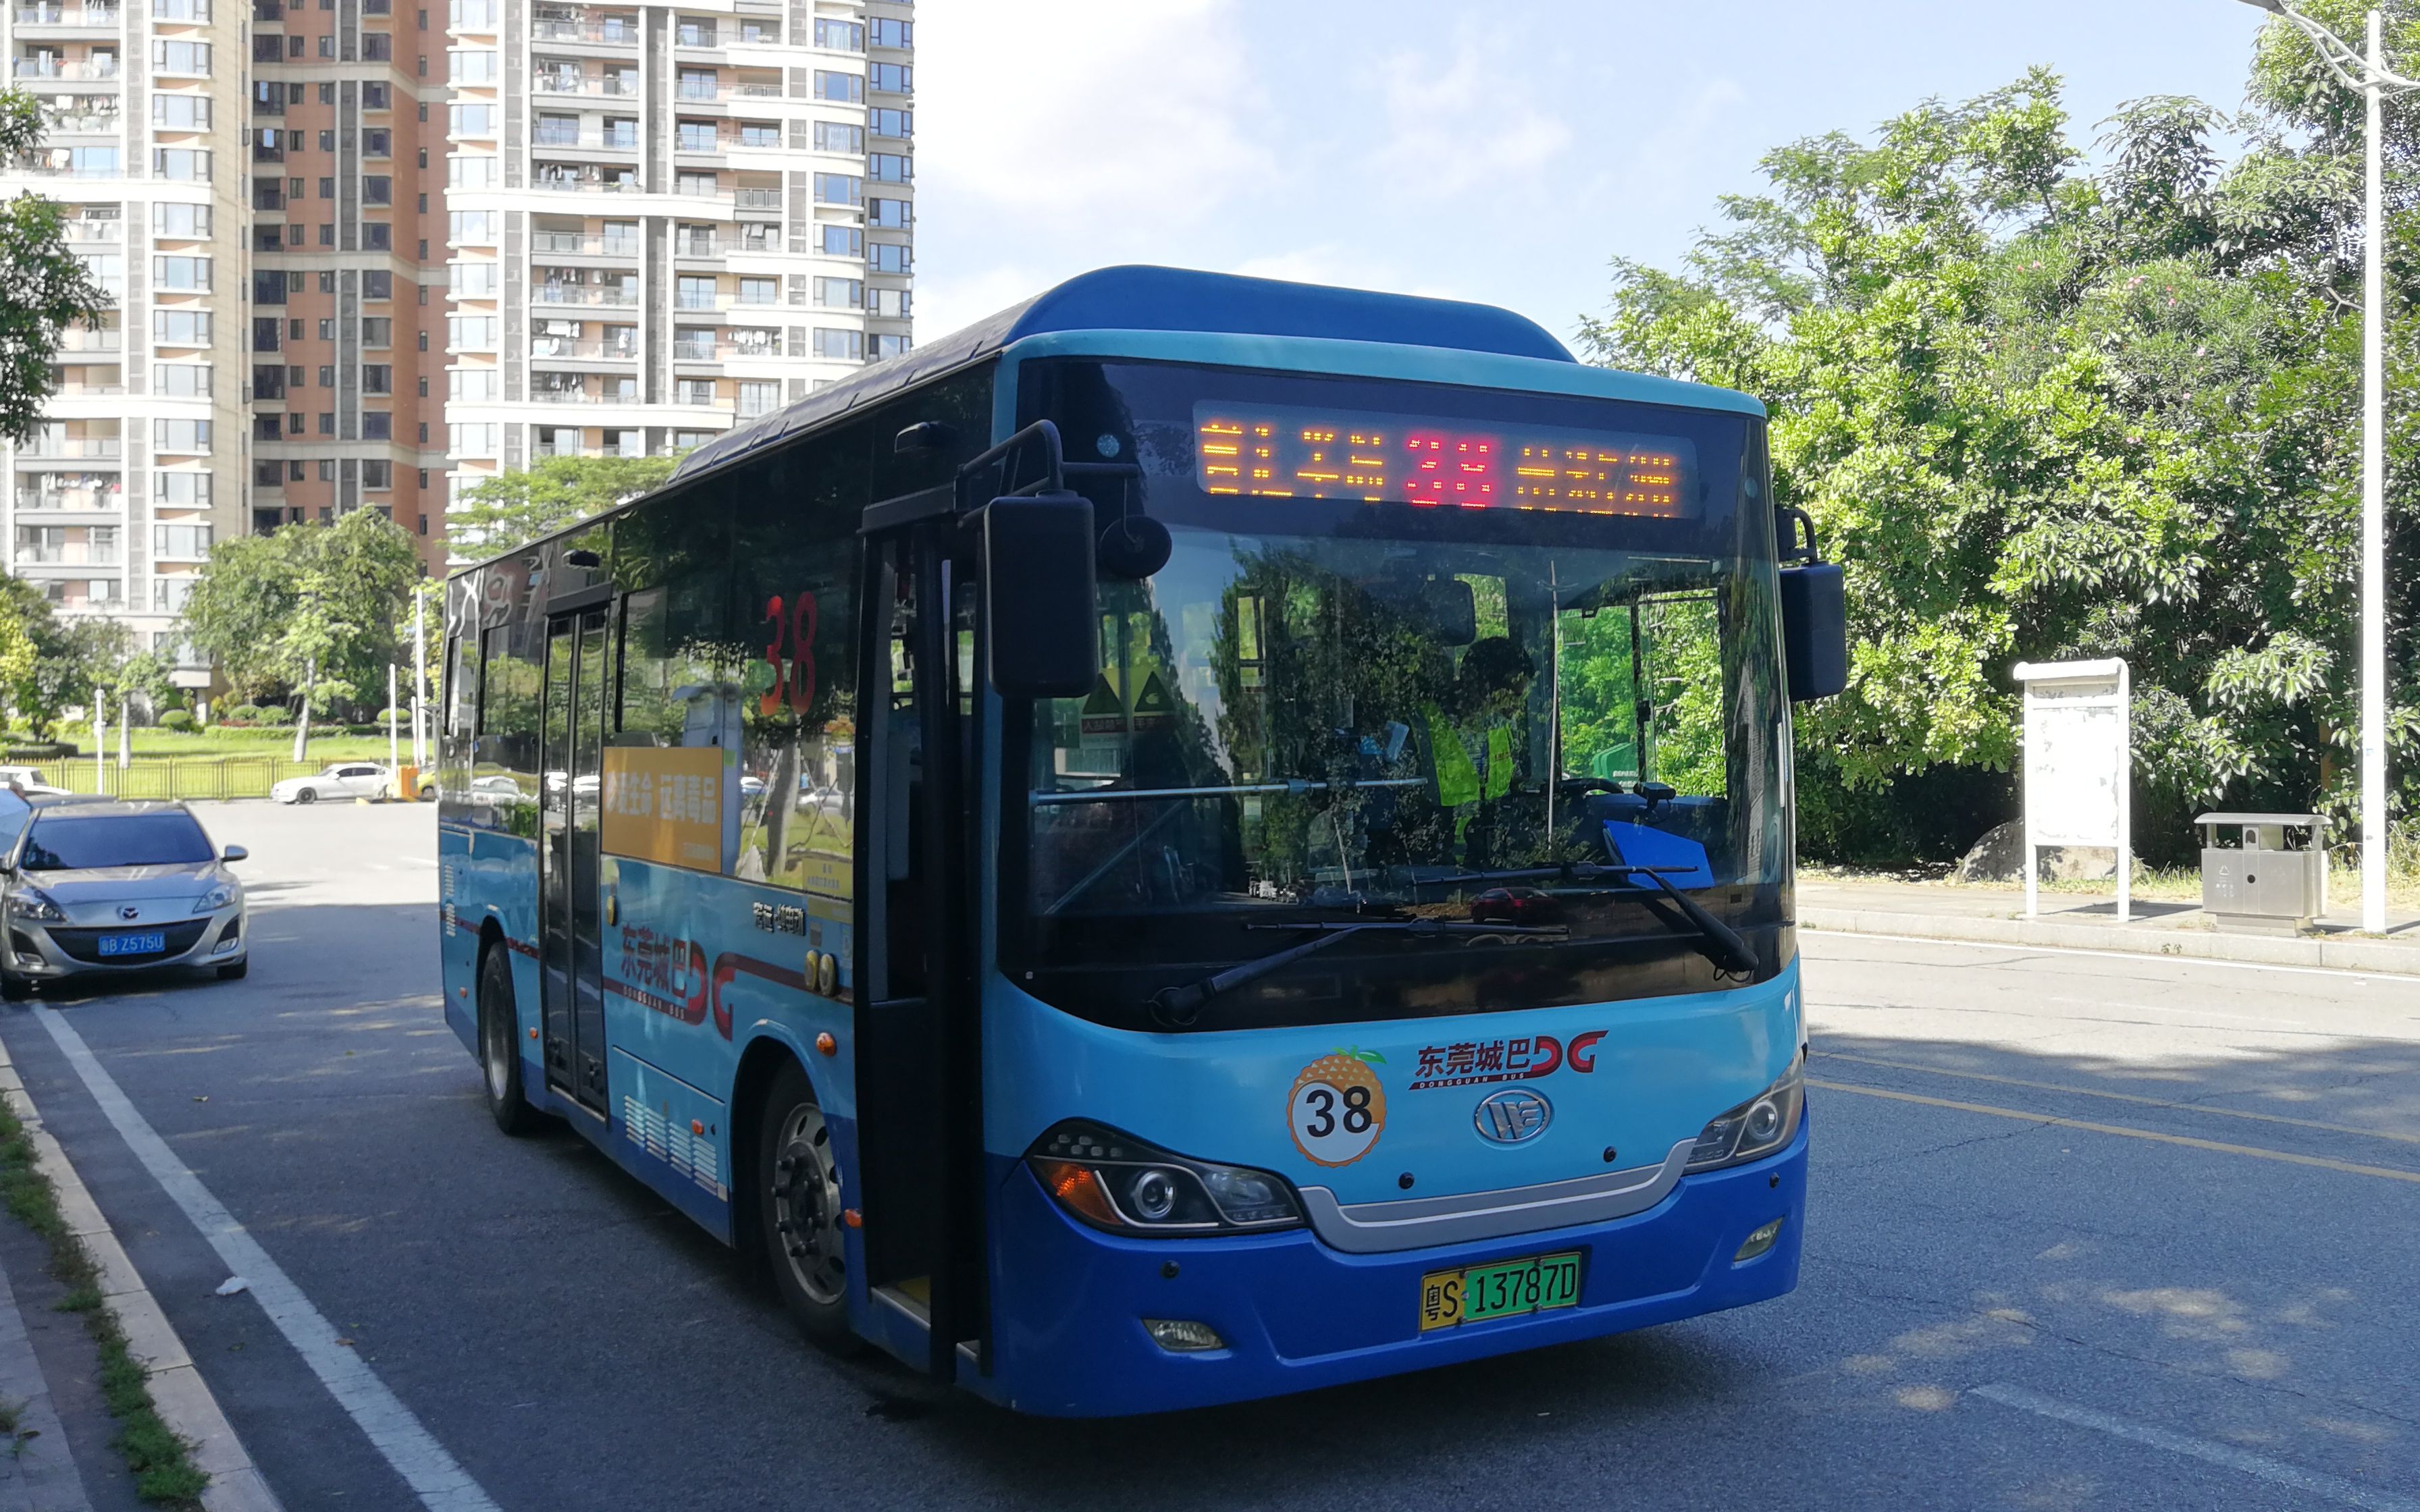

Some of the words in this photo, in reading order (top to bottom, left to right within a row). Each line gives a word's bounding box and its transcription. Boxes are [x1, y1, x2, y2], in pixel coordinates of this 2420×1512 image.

[1406, 439, 1491, 508] 38
[760, 591, 817, 717] 38
[621, 924, 687, 999] 东莞城巴
[1415, 1040, 1531, 1079] 东莞城巴
[1419, 1075, 1489, 1089] DONGGUAN
[1502, 1072, 1525, 1081] BUS
[1305, 1085, 1373, 1138] 38
[1475, 1262, 1577, 1313] 13787D
